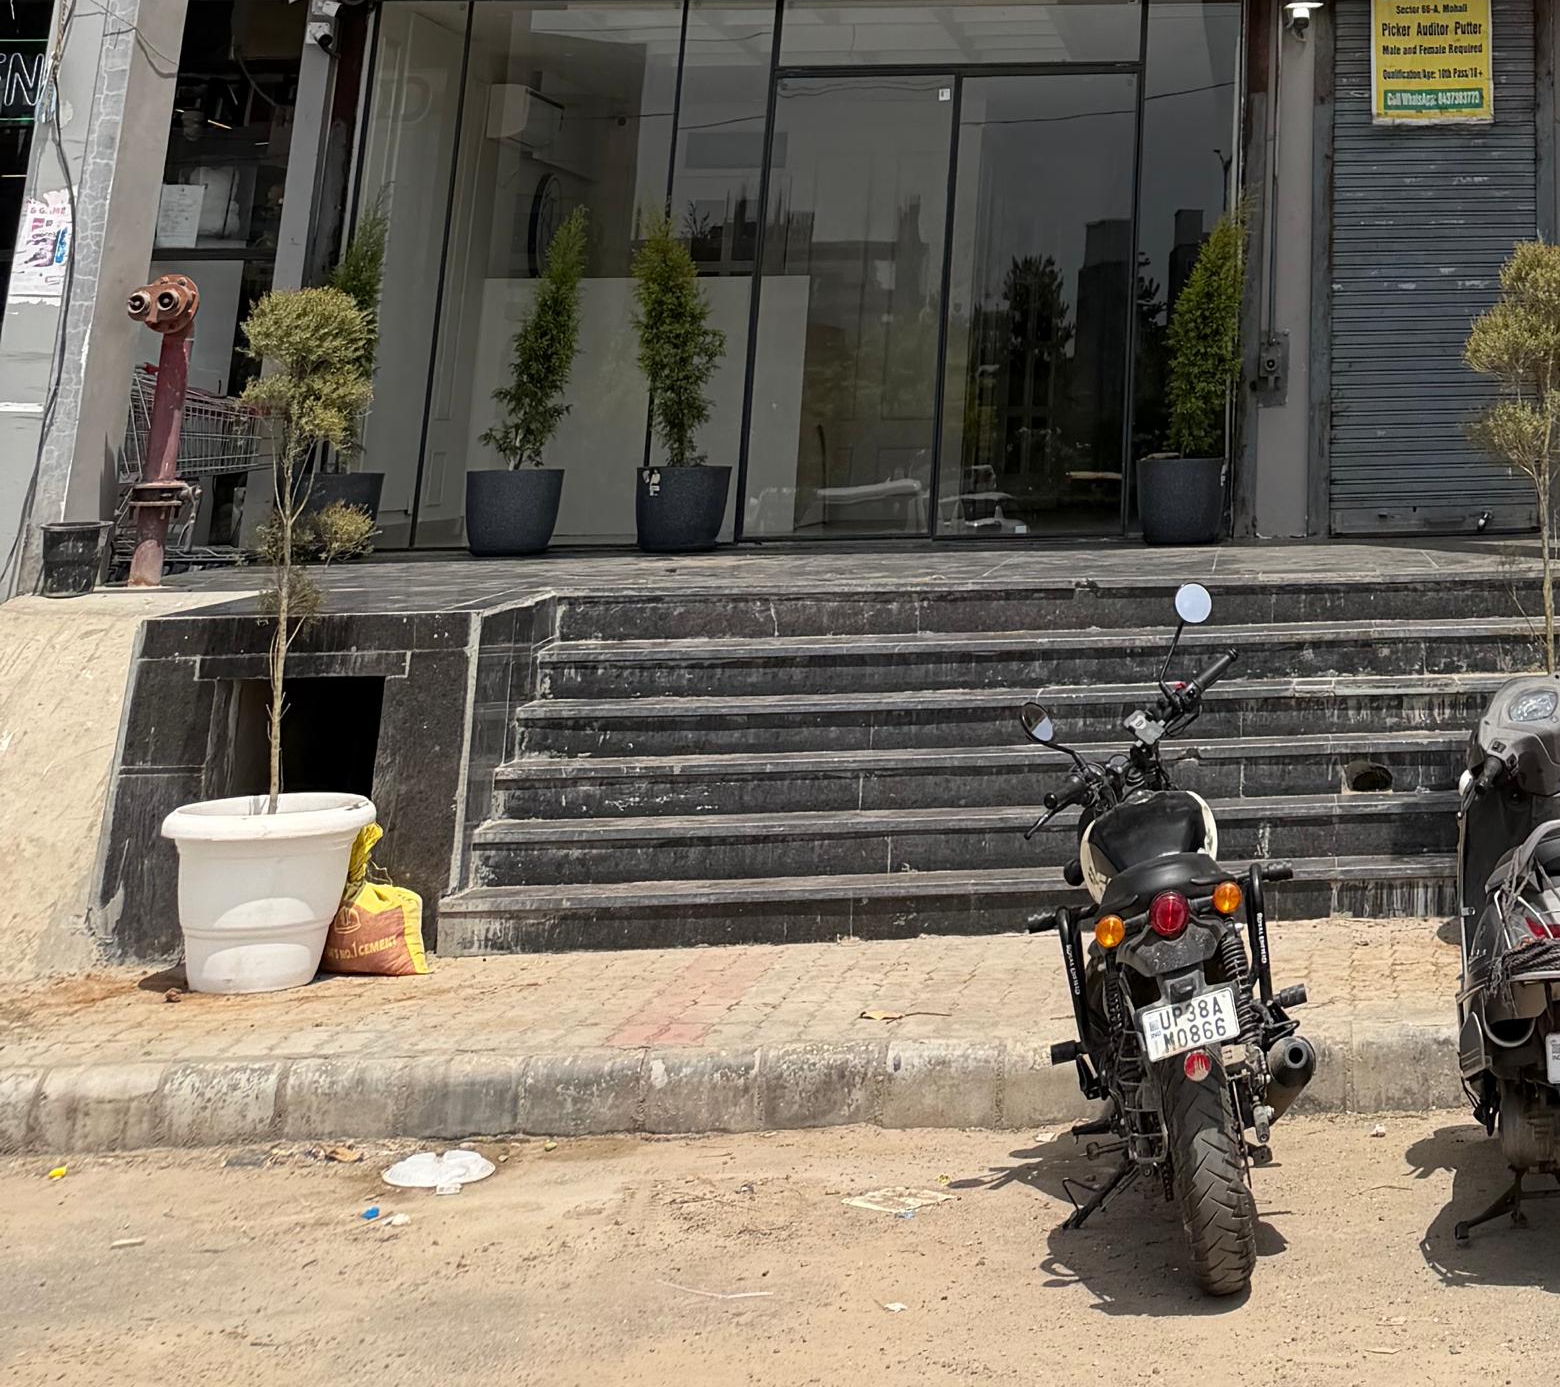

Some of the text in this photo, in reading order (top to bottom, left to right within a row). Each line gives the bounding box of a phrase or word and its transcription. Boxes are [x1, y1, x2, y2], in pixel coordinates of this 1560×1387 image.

[1381, 21, 1482, 37] Picker Auditor Putter
[1382, 43, 1483, 55] Male and Female Required
[358, 935, 397, 956] CEMENT
[1159, 996, 1223, 1030] UP38A
[1163, 1017, 1227, 1053] M0866
